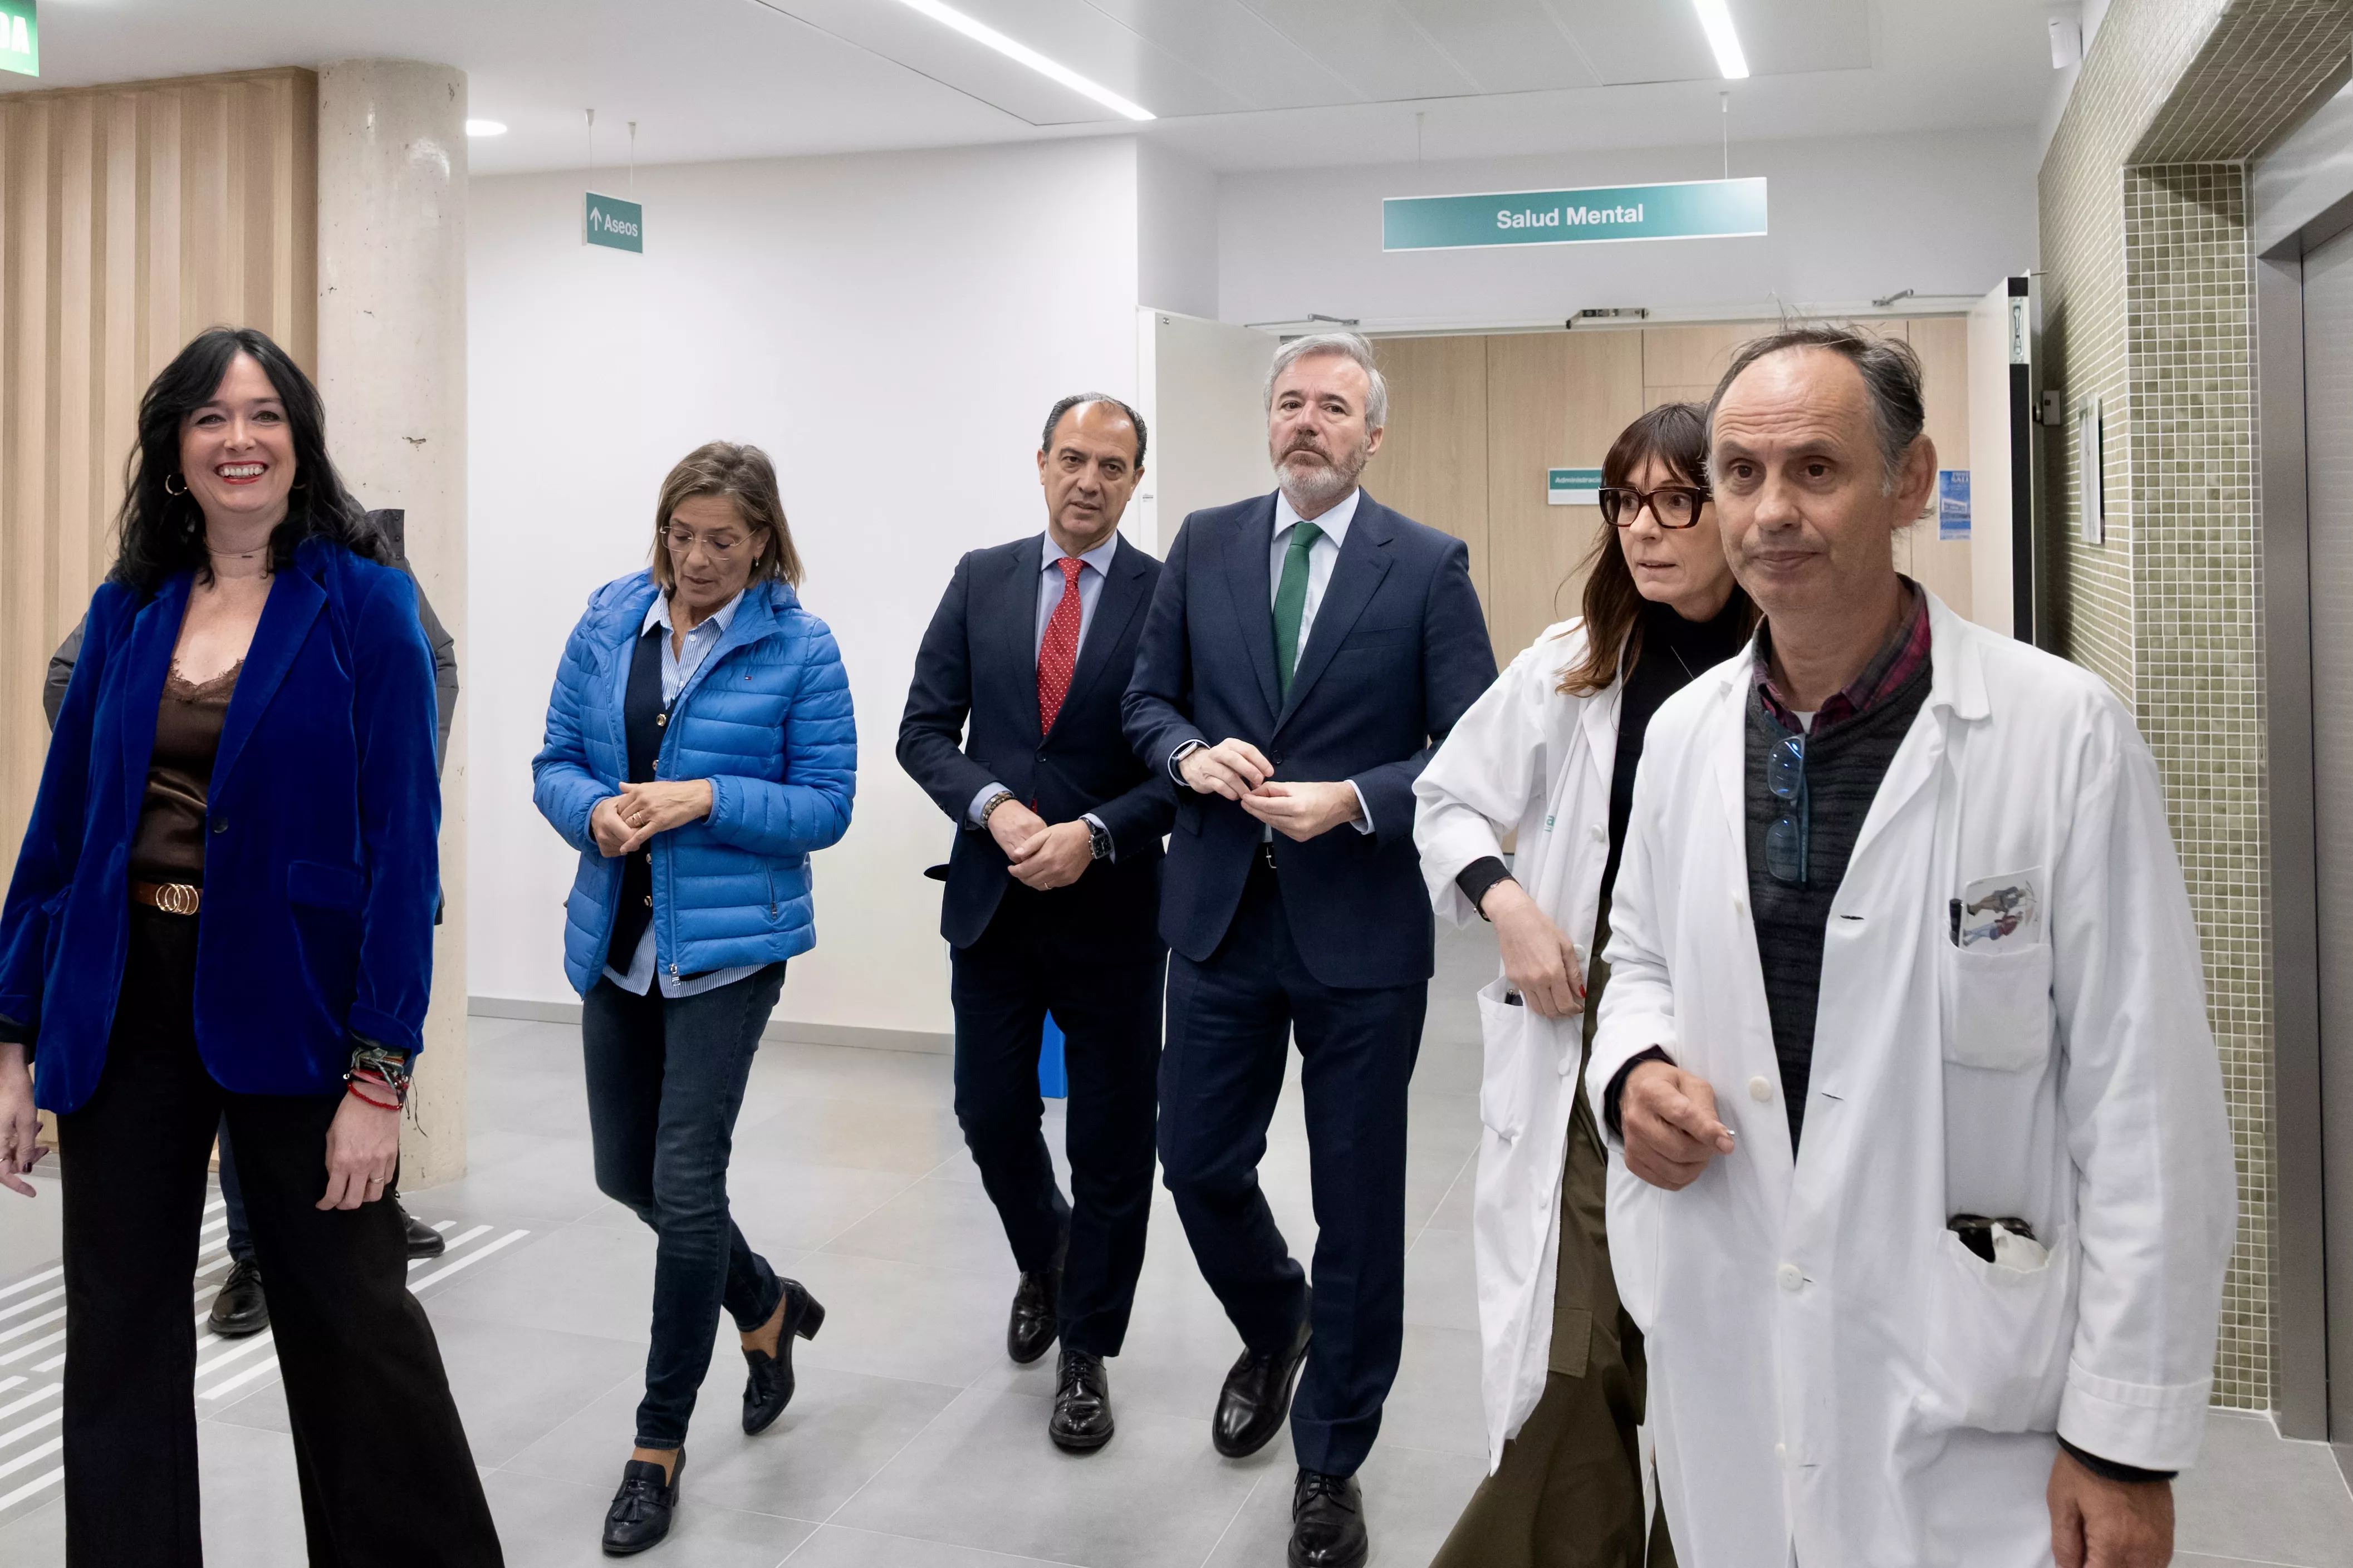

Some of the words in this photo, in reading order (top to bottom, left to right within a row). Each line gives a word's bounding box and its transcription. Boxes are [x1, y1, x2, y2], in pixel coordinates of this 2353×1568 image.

[604, 213, 638, 237] Aseos
[1496, 208, 1559, 229] Salud
[1566, 203, 1643, 225] Mental
